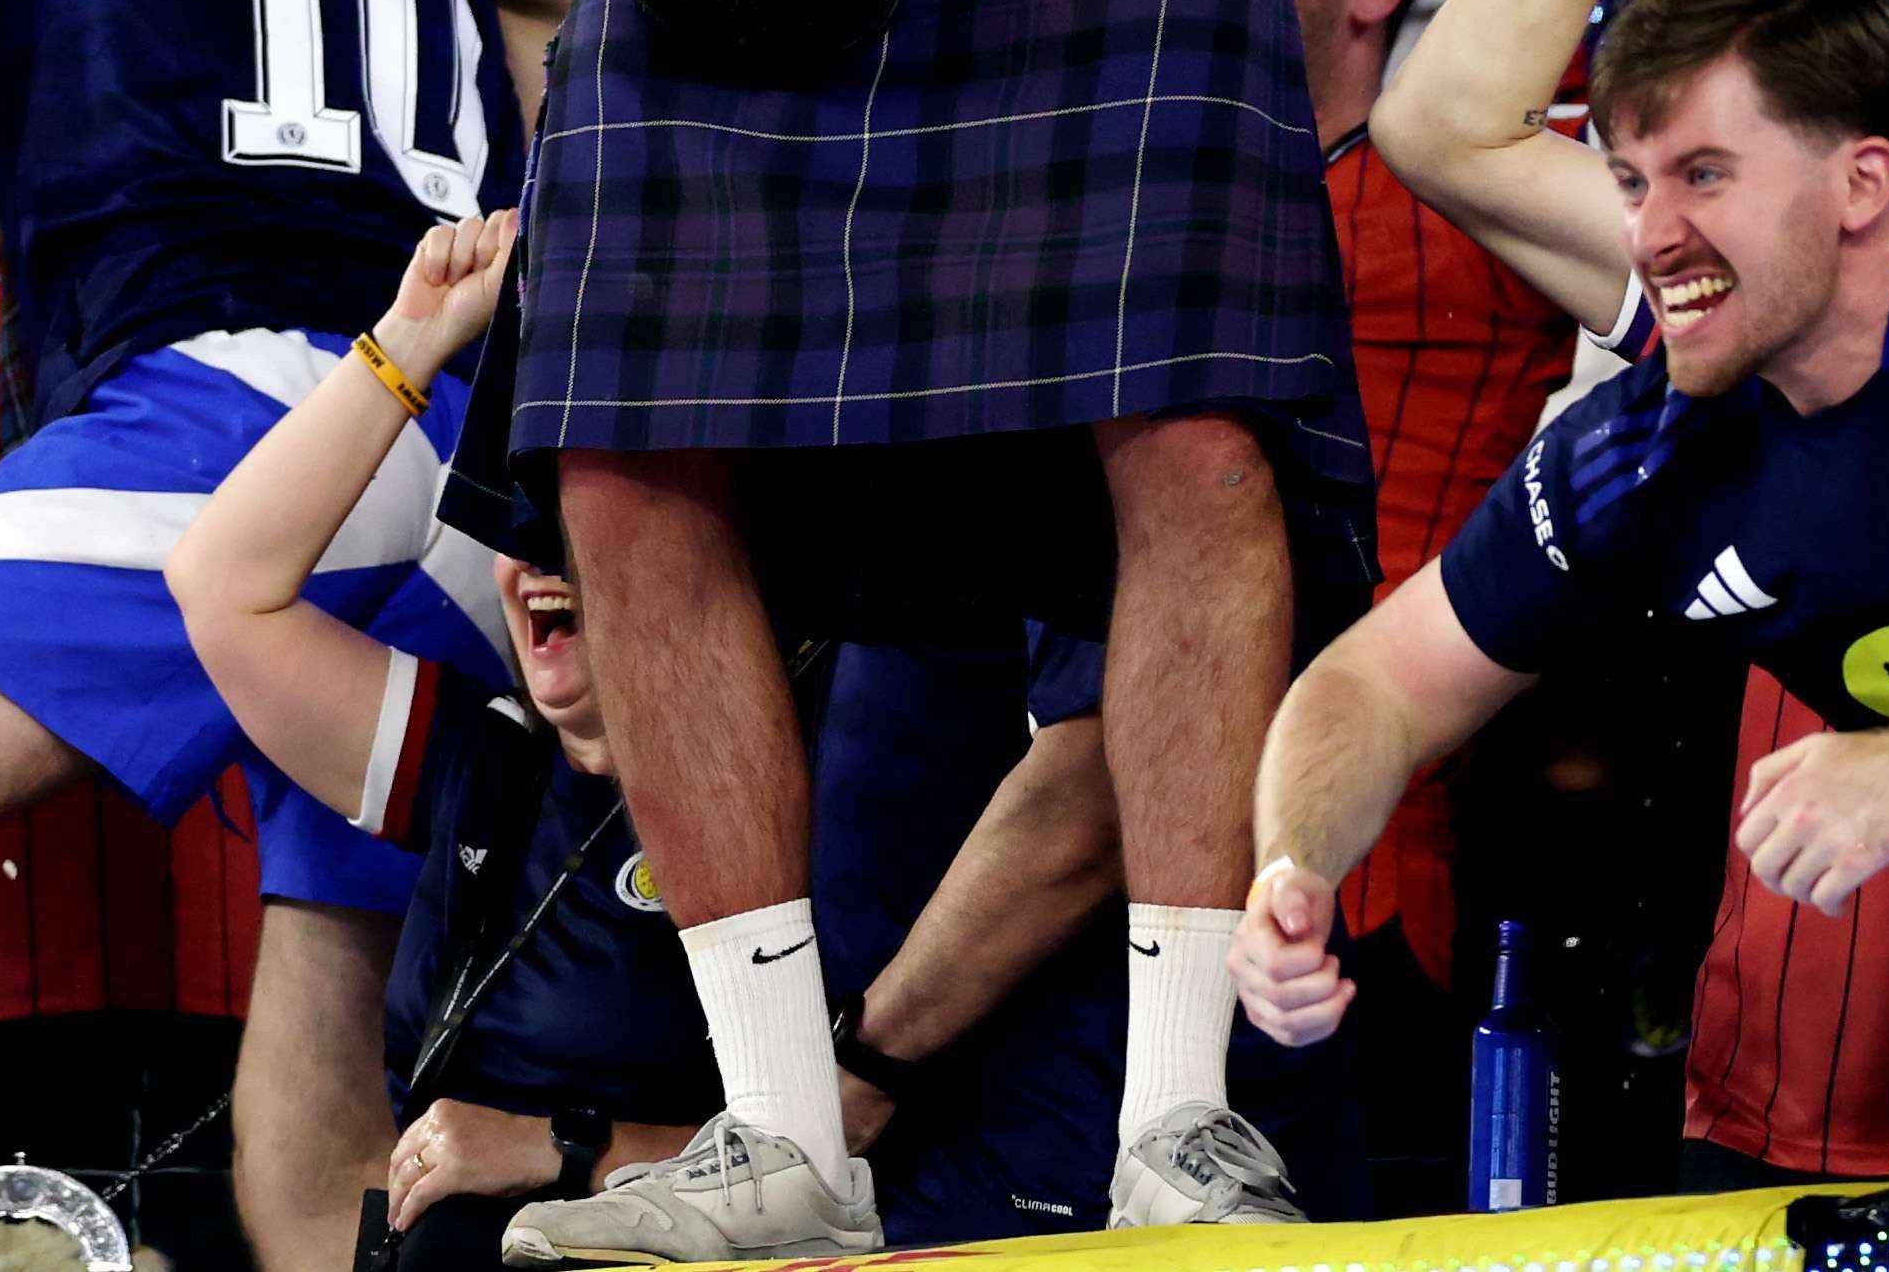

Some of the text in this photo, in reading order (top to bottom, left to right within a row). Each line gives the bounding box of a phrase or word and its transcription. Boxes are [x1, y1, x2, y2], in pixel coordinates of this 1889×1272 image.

[1523, 439, 1554, 548] CHASE
[1546, 1070, 1562, 1205] BUD LIGHT
[1014, 1198, 1074, 1217] CLIMACOOL
